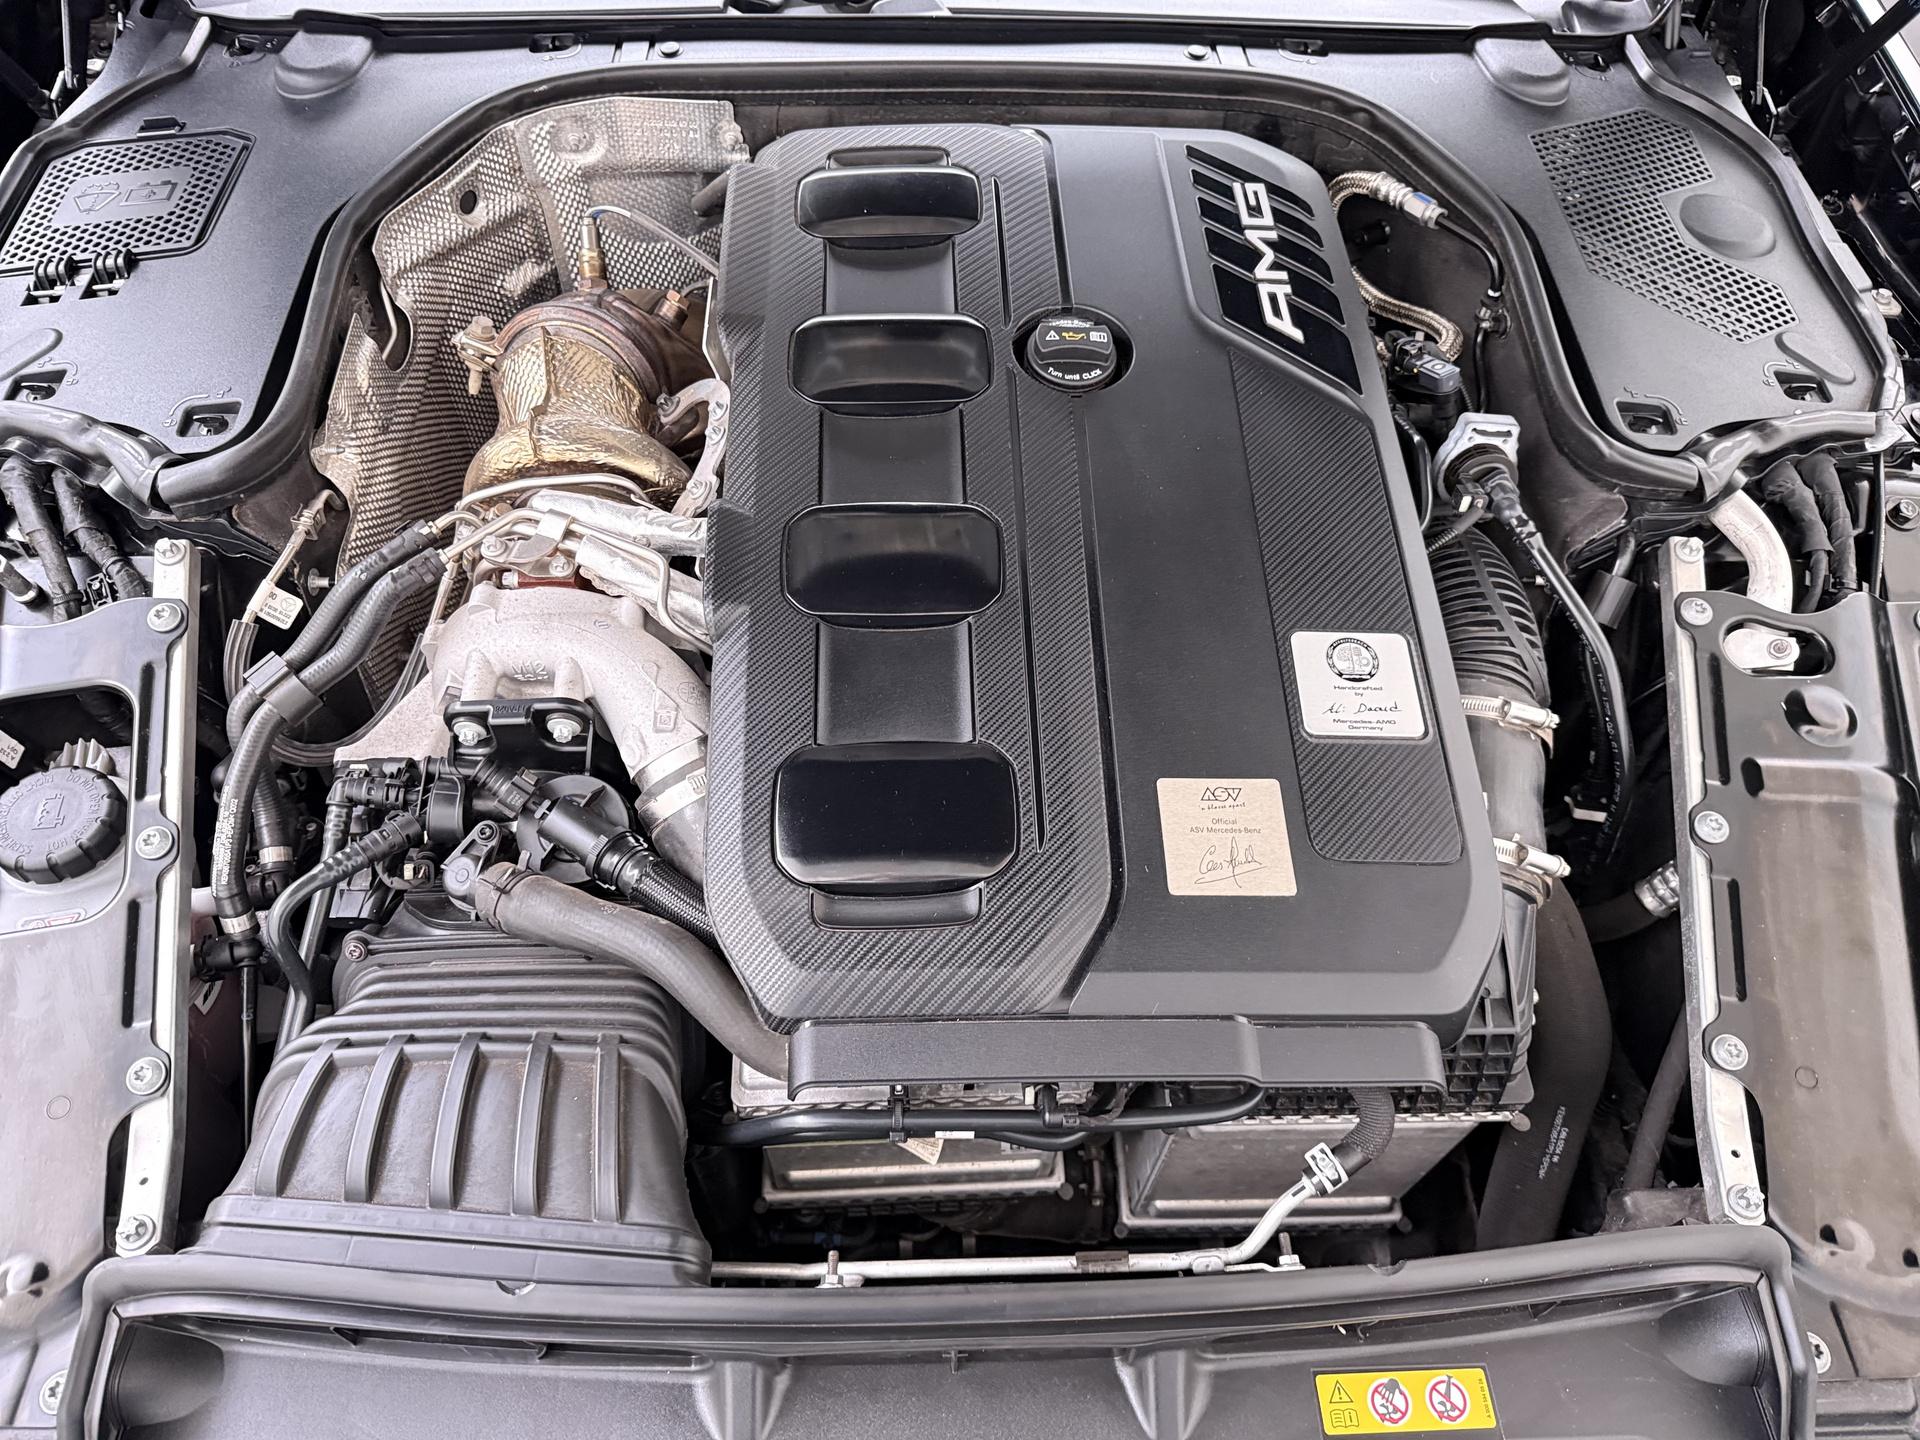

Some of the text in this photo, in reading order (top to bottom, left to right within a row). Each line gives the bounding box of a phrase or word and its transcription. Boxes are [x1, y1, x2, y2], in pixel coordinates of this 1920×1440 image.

[1232, 182, 1305, 344] AMG
[1047, 366, 1063, 378] Turn
[1082, 368, 1103, 380] CLICK
[1347, 724, 1384, 732] Germany
[1200, 786, 1242, 802] ASV
[1228, 802, 1246, 810] apart
[1211, 817, 1238, 825] Official
[1189, 826, 1262, 834] ASV Mercedes-Benz
